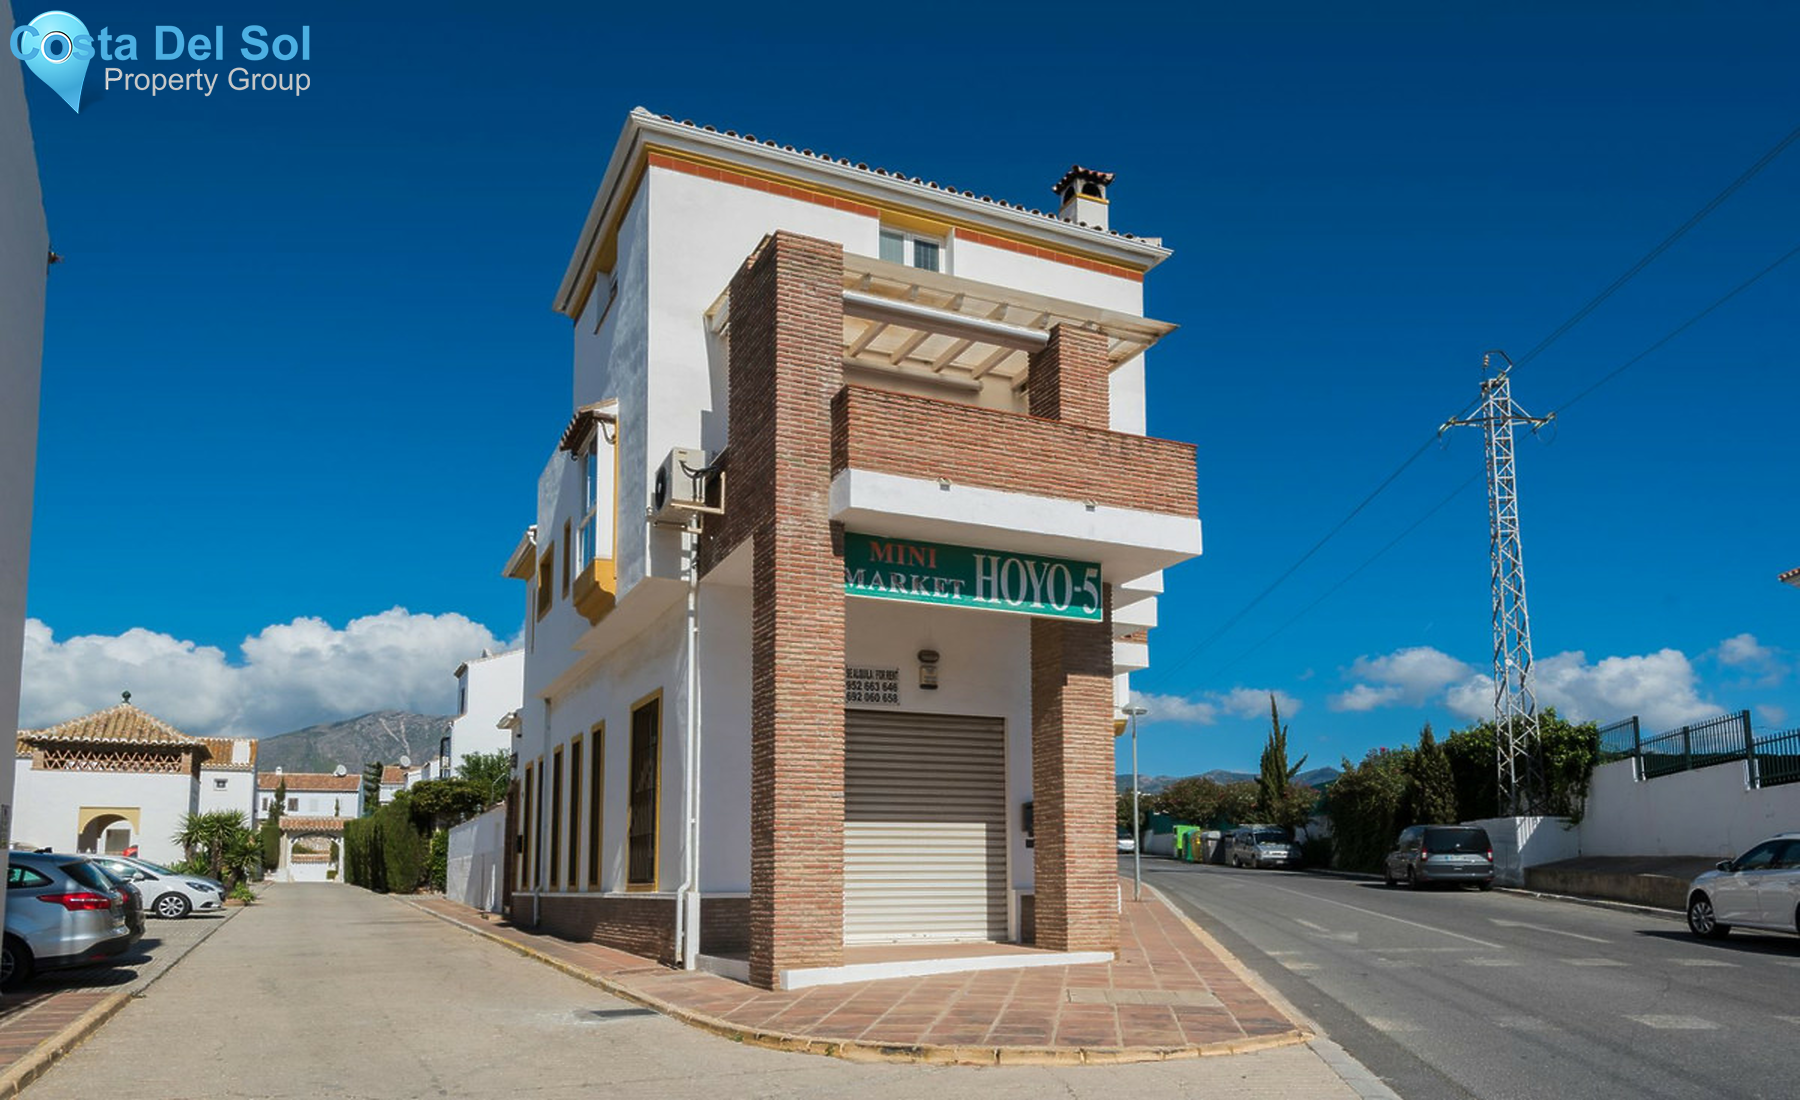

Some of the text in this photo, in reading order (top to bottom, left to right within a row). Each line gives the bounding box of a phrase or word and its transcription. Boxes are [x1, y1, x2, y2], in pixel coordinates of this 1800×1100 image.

[870, 541, 937, 569] MINI
[844, 553, 1099, 614] MARKET HOYO-5
[864, 681, 880, 692] 663
